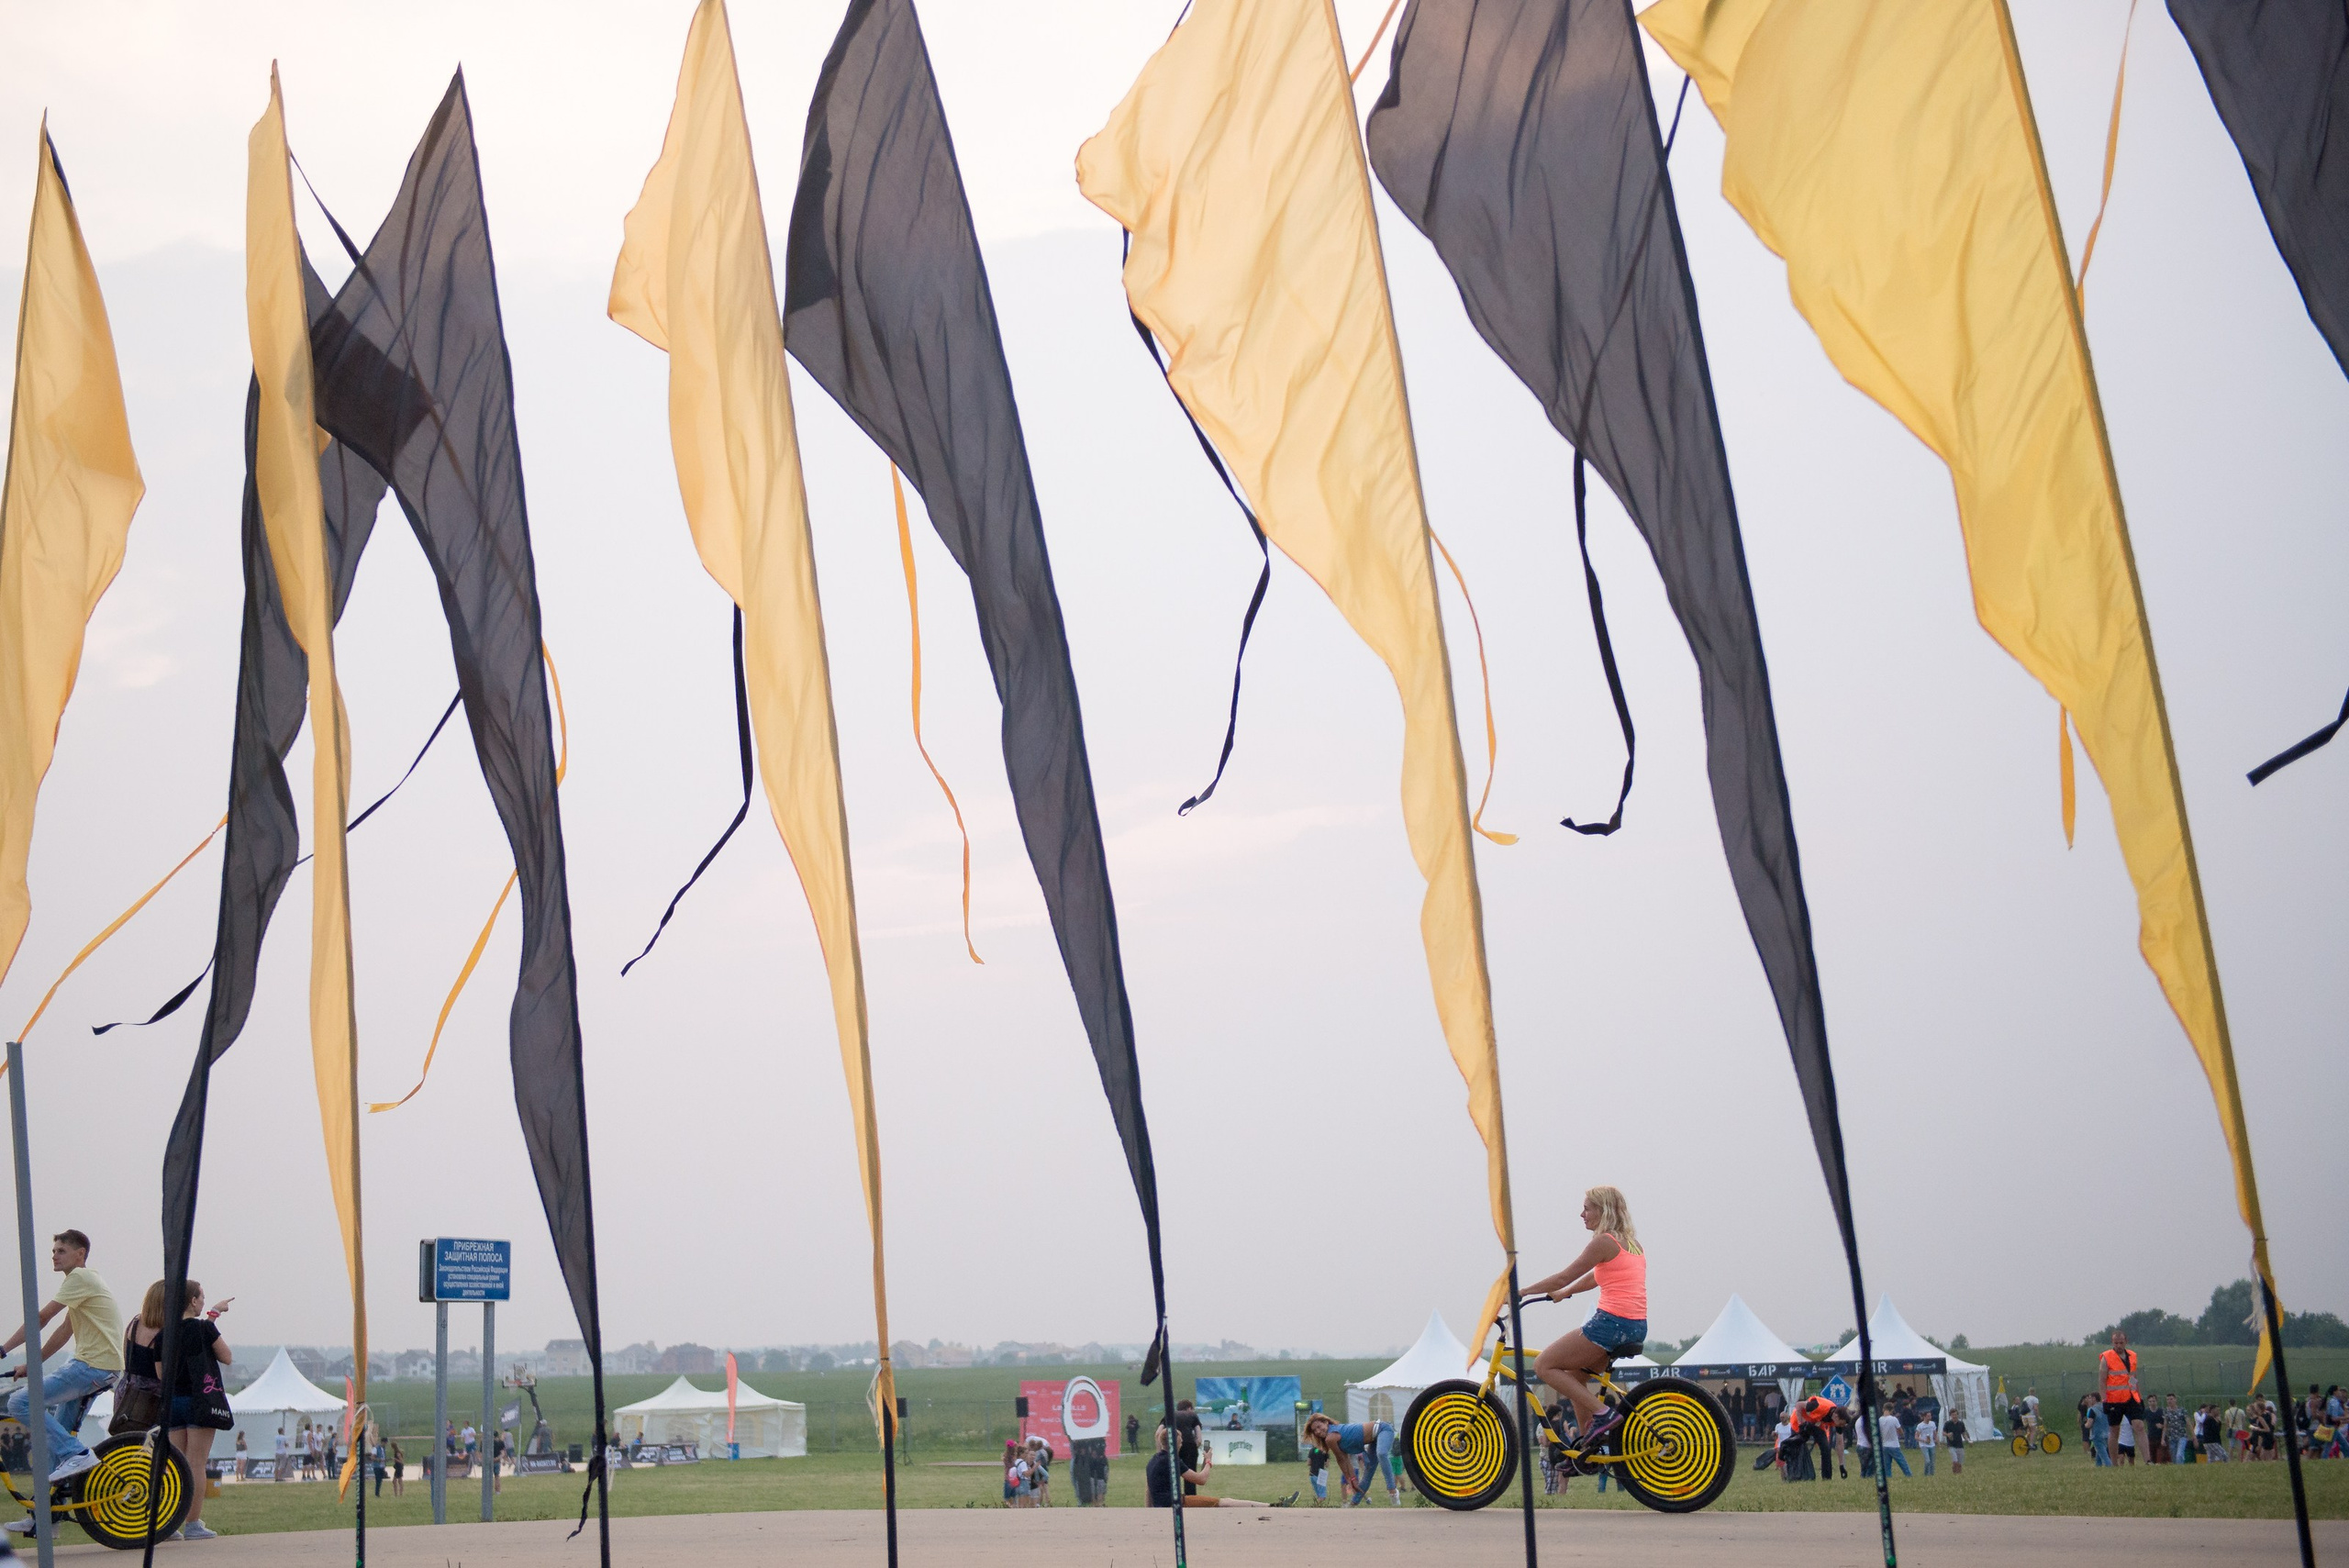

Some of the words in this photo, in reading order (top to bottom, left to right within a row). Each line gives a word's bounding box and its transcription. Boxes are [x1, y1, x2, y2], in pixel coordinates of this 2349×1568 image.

[453, 1241, 495, 1251] ПРИБРЕЖНАЯ
[444, 1251, 478, 1262] ЗАЩИТНАЯ
[478, 1252, 503, 1262] ПОЛОСА
[1650, 1367, 1681, 1378] BAR
[1748, 1364, 1777, 1376] БАР
[1855, 1362, 1887, 1373] BR
